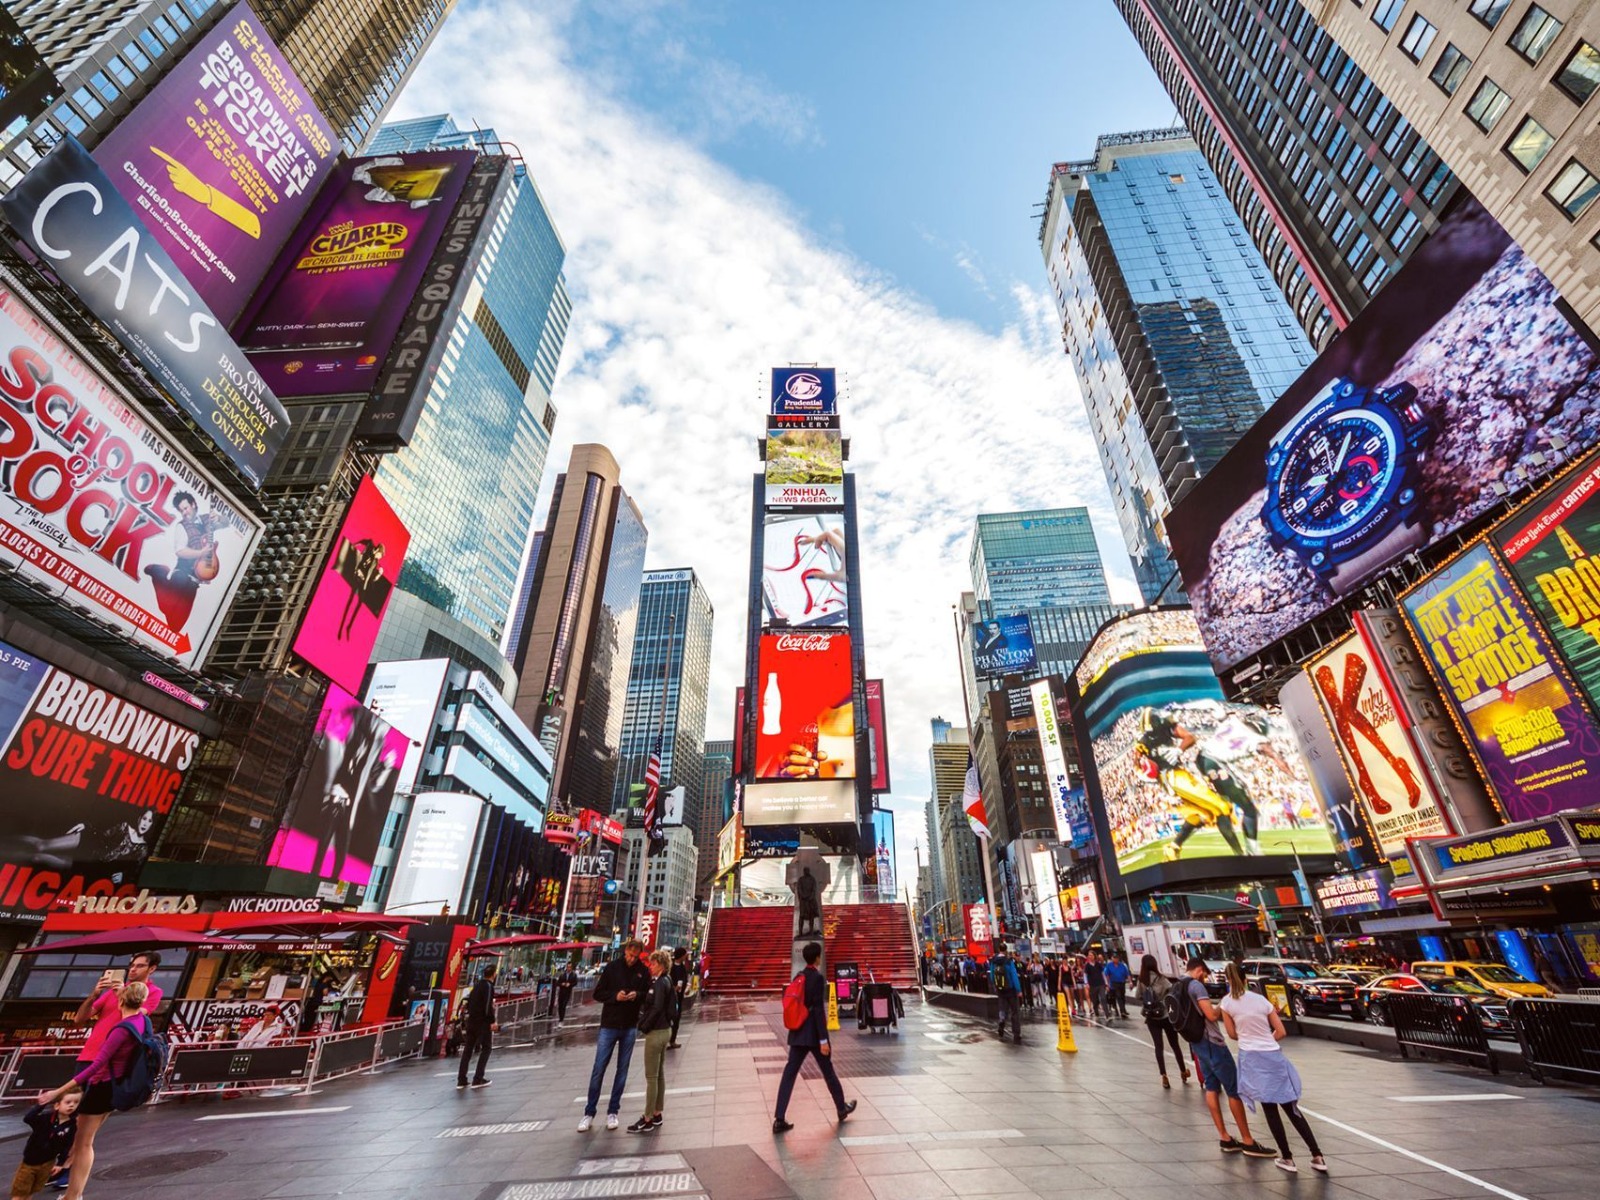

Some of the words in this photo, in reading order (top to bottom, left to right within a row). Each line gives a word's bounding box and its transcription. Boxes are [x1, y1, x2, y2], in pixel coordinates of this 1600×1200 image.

[232, 25, 252, 51] THE
[250, 52, 299, 115] CHOCOLATE
[295, 115, 328, 159] FACTORY
[240, 19, 303, 111] CHARLIE
[302, 113, 332, 152] AND
[207, 53, 309, 192] GOLDEN
[216, 40, 317, 178] BROADWAY'S
[199, 62, 302, 199] TICKET
[186, 116, 205, 139] ON
[229, 169, 268, 214] STREET
[194, 98, 209, 116] IS
[209, 117, 239, 151] JUST
[237, 152, 279, 204] AROUND
[201, 119, 225, 147] THE
[223, 147, 266, 200] CORNER
[123, 161, 237, 283] CharlieOnBroadway.com
[446, 171, 497, 253] TIMES
[312, 223, 405, 254] CHARLIE
[32, 181, 216, 352] CATS
[312, 254, 364, 266] CHOCOLATE
[366, 249, 403, 260] FACTORY
[326, 265, 347, 274] NEW
[348, 261, 389, 271] MUSICAL
[283, 323, 306, 331] DARK
[316, 321, 366, 329] SEMI-SWEET
[383, 263, 455, 394] SQUARE
[133, 333, 191, 397] CATSBROADWAY.COM
[246, 370, 266, 396] ON
[217, 353, 278, 430] BROADWAY
[218, 373, 267, 437] THROUGH
[201, 377, 256, 445] DECEMBER
[253, 439, 266, 455] 30
[211, 410, 246, 452] ONLY!
[372, 412, 396, 420] NYC
[1284, 401, 1336, 450] G-SHOCK
[0, 345, 176, 527] SCHOOL
[1309, 435, 1330, 460] 12
[64, 453, 114, 489] of
[97, 386, 143, 437] WEBBER
[141, 428, 163, 457] HAS
[161, 450, 212, 502] BROADWAY
[211, 494, 250, 537] ROCKING!
[783, 488, 827, 496] XINHUA
[1313, 494, 1335, 518] SAT
[23, 505, 39, 518] THE
[1332, 507, 1389, 550] PROTECTION
[1504, 545, 1517, 559] The
[1514, 534, 1529, 551] New
[1527, 521, 1546, 541] York
[1541, 504, 1565, 527] Times
[1562, 474, 1596, 510] CRITICS'
[29, 518, 68, 545] MUSICAL
[1554, 524, 1586, 561] A
[647, 573, 674, 581] Allianz
[41, 550, 57, 570] TO
[55, 560, 78, 584] THE
[77, 573, 116, 605] WINTER
[113, 597, 152, 626] GARDEN
[146, 616, 181, 647] THEATRE
[1417, 601, 1454, 644] NOT
[1449, 568, 1507, 625] JUST
[776, 634, 833, 652] Coca-Cola
[1431, 638, 1450, 669] A
[1447, 598, 1526, 655] SIMPLE
[12, 656, 31, 672] PIE
[974, 648, 1034, 666] PHANTOM
[1005, 658, 1030, 666] OPERA
[1444, 625, 1547, 702] SPONGE
[146, 673, 185, 699] OUTFRONT
[1383, 618, 1468, 779] PALACE
[35, 671, 200, 773] BROADWAY'S
[1041, 692, 1055, 731] 10,000
[1048, 732, 1058, 746] SF
[1372, 705, 1397, 730] Boots
[1493, 706, 1559, 744] SPONGEBOB
[1501, 723, 1566, 757] SQUAREPANTS
[7, 718, 106, 790] SURE
[97, 748, 183, 815] THING
[1375, 817, 1398, 832] WINNER!
[1402, 811, 1418, 825] TONY
[1379, 829, 1403, 839] INCLUDING
[1403, 823, 1418, 832] BEST
[1449, 841, 1495, 864] SPONGEBOB
[1491, 829, 1552, 855] SQUAREPANTS
[73, 888, 198, 915] nuchas
[1337, 881, 1358, 895] CENTER
[1364, 878, 1379, 890] THE
[228, 899, 255, 913] NYC
[251, 898, 321, 913] HOTDOGS
[1446, 901, 1480, 910] PREVIEWS
[642, 912, 655, 946] tkts
[969, 906, 986, 942] tkts
[414, 942, 448, 958] BEST
[208, 1004, 267, 1018] SnackBo
[578, 1158, 643, 1175] 54
[574, 1172, 690, 1198] BROADWAY
